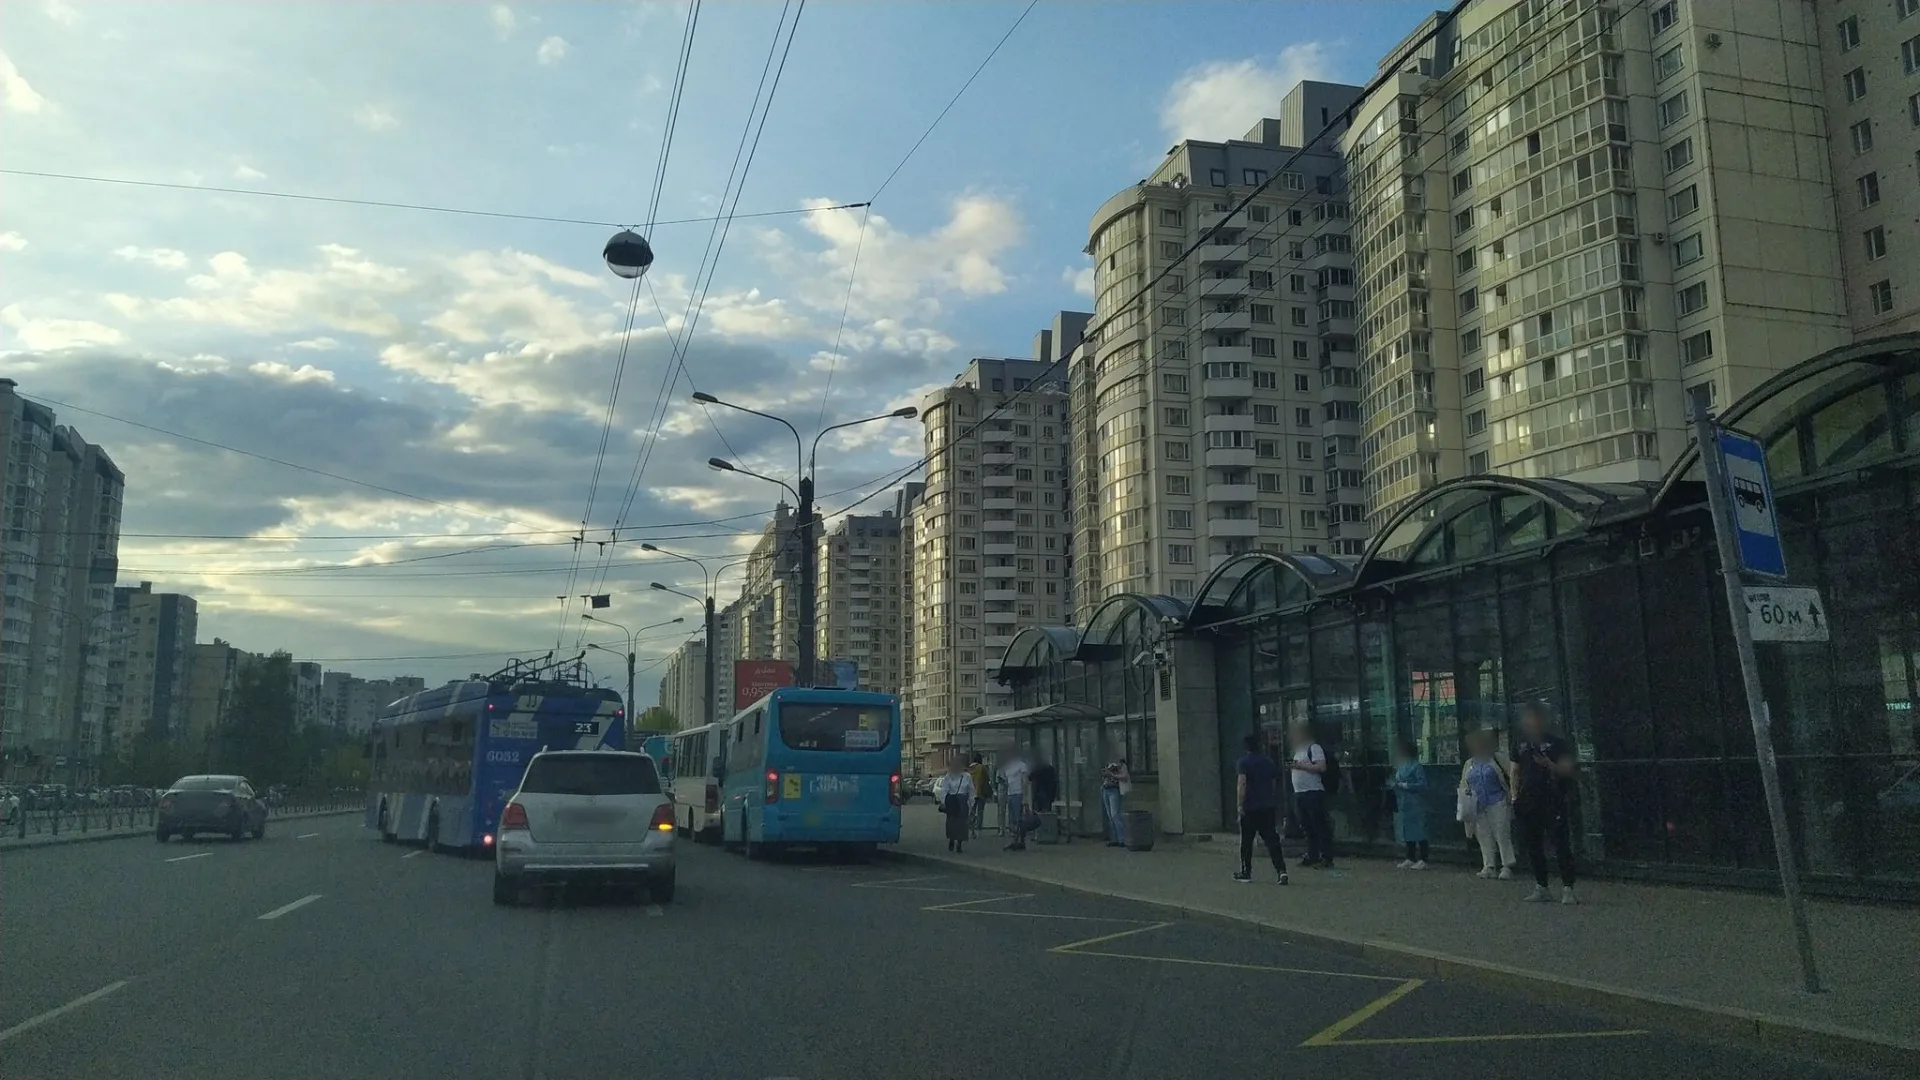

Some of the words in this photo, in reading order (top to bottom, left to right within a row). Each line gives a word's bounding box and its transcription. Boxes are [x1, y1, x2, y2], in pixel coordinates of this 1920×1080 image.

[1760, 604, 1784, 624] 60
[574, 722, 593, 733] 23
[486, 750, 520, 762] 6052
